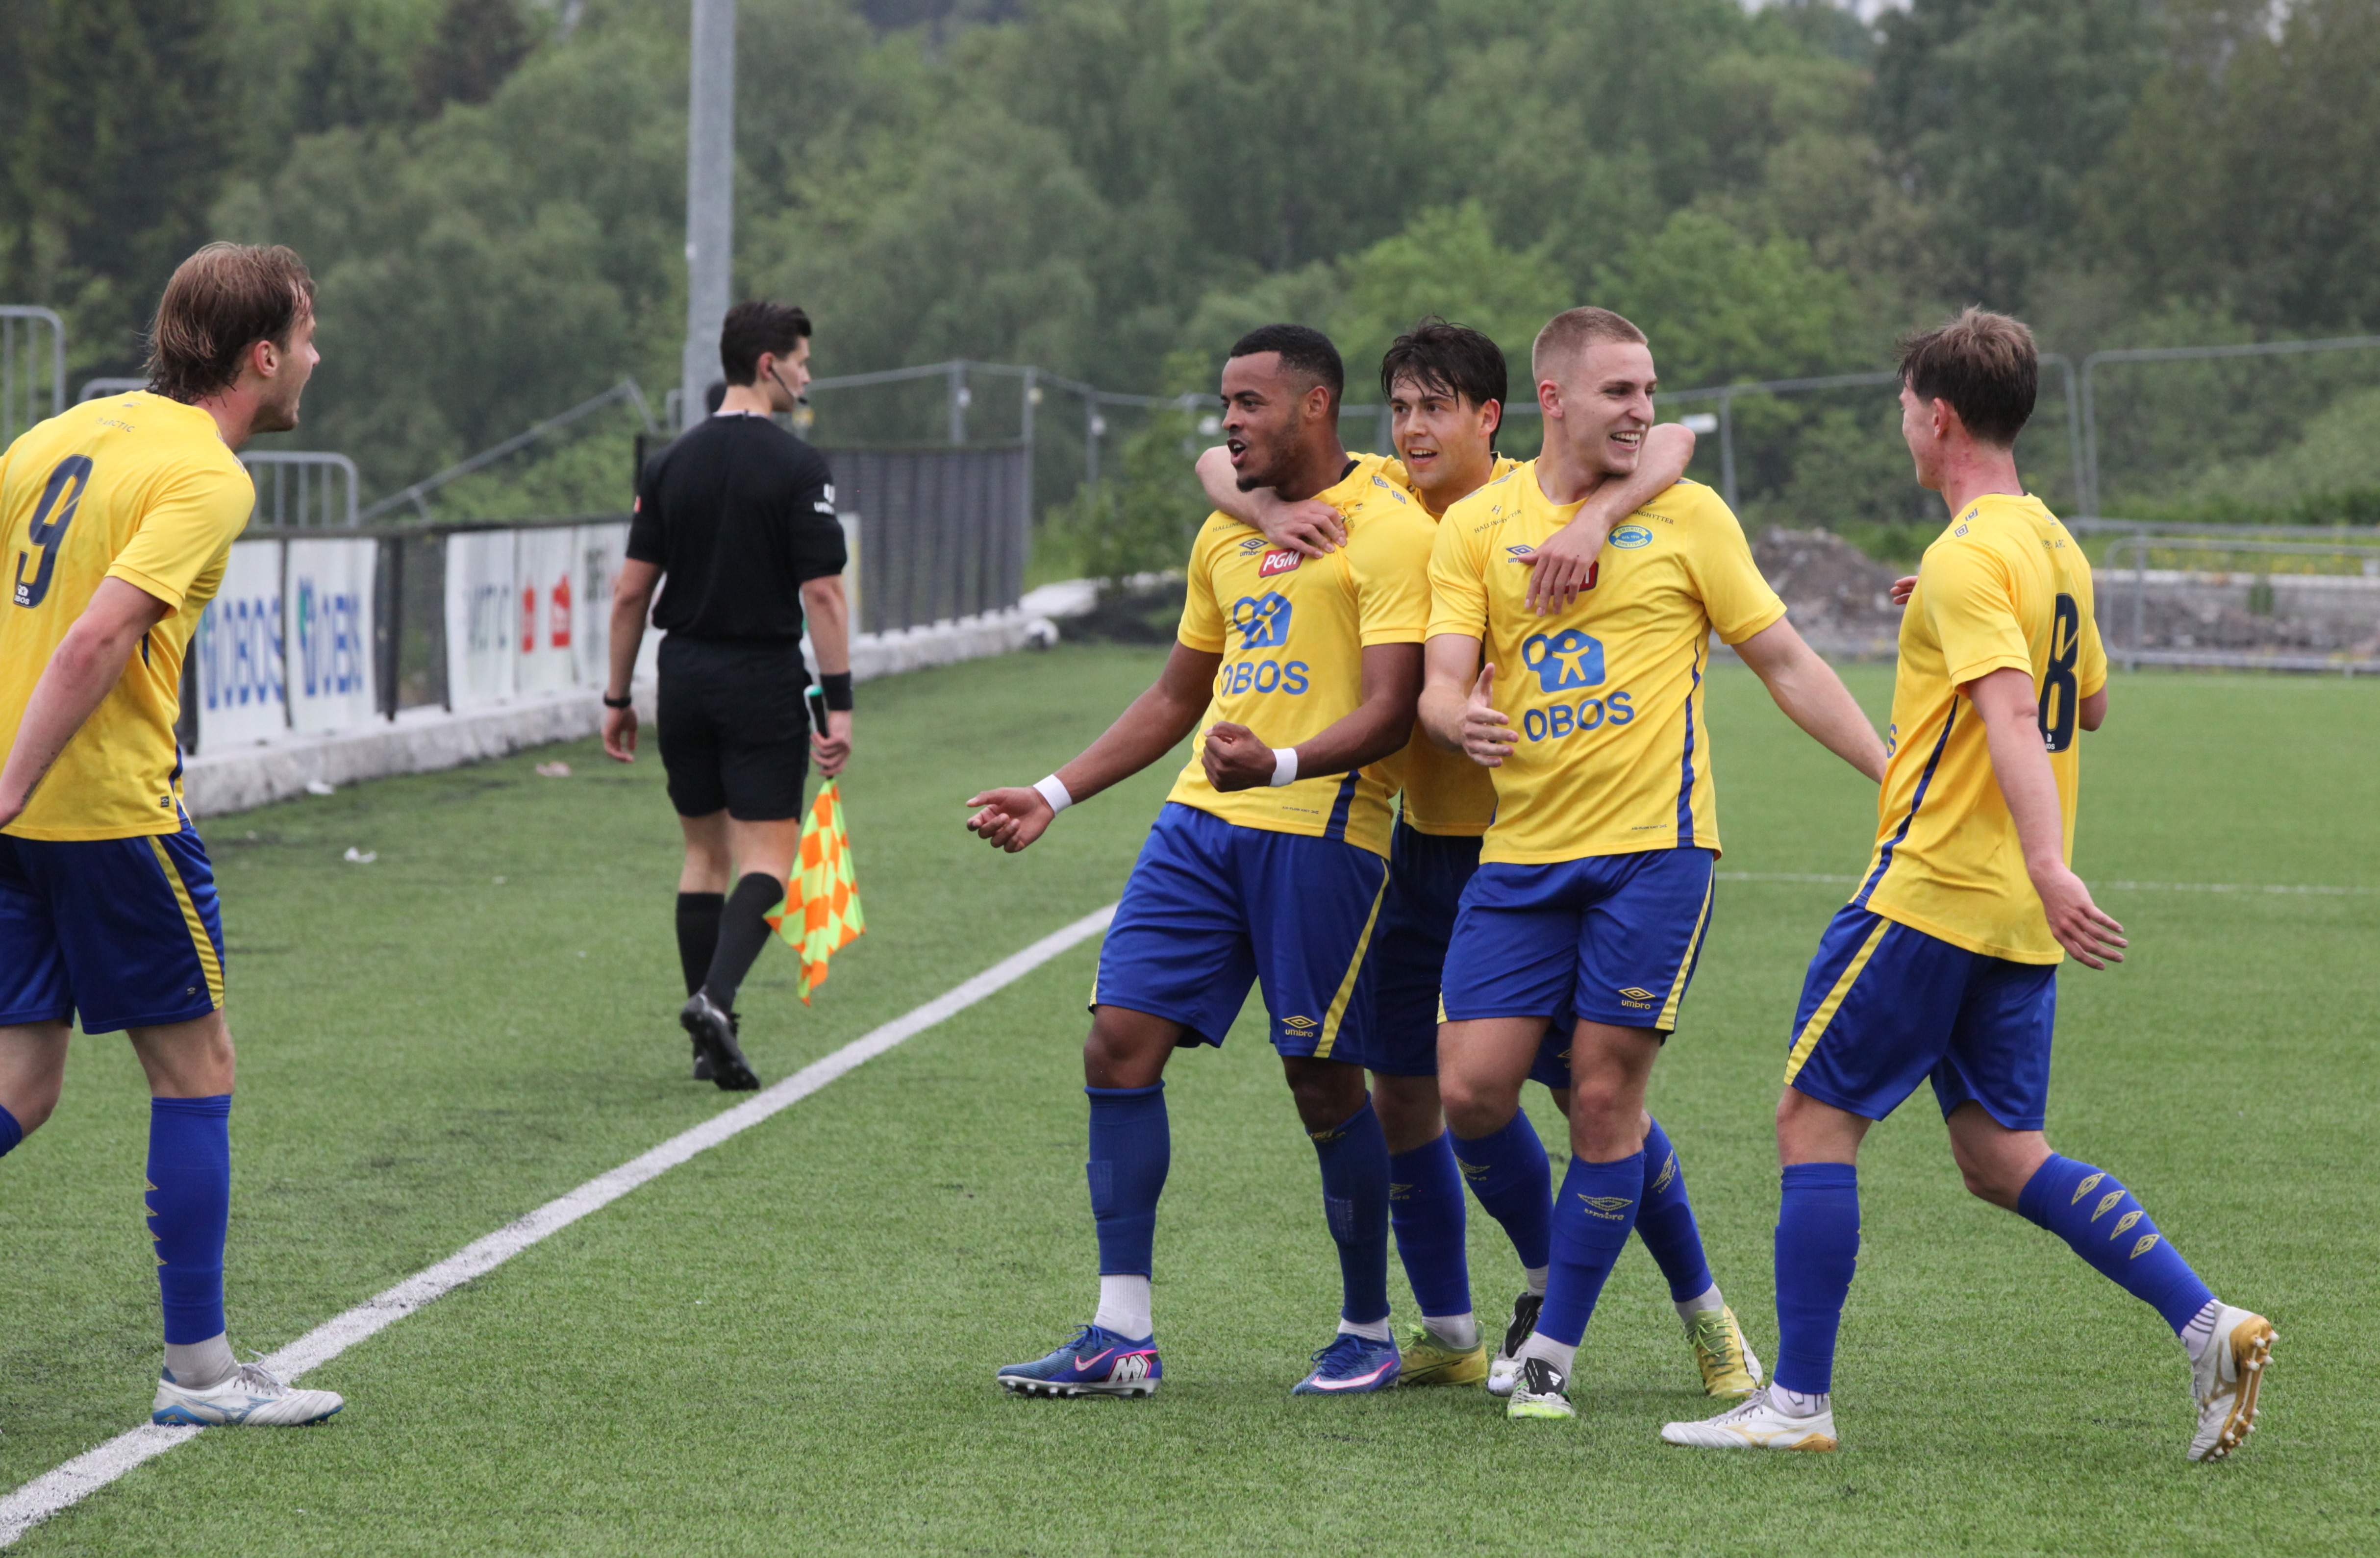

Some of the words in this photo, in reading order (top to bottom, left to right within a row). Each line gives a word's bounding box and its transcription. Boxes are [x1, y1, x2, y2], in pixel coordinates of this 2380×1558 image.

[13, 454, 94, 609] 9
[1262, 549, 1300, 571] PGM
[1221, 660, 1309, 697] OBOS
[2038, 593, 2079, 752] 8
[1524, 691, 1634, 742] OBOS
[1622, 1000, 1651, 1010] umbro
[1285, 1029, 1313, 1037] umbro
